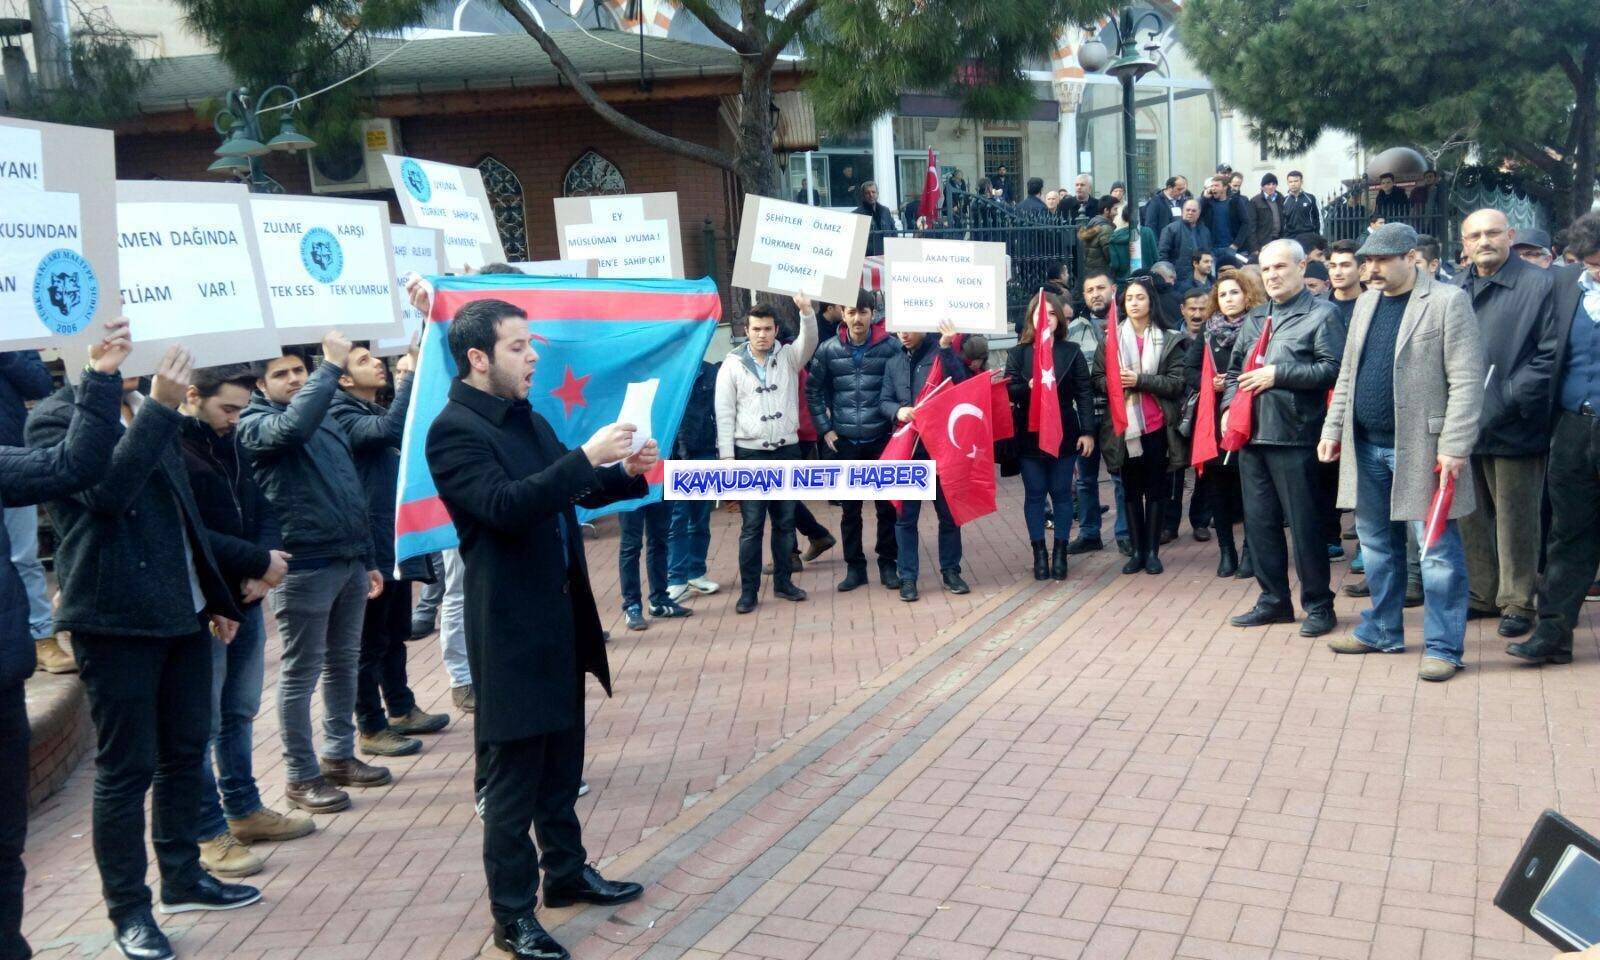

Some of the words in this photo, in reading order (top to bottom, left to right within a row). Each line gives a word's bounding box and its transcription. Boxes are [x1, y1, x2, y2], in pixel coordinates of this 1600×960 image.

[612, 213, 623, 221] EY
[766, 213, 803, 226] ŞEHİTLER
[813, 220, 841, 233] ÖLMEZ
[170, 226, 238, 246] DAĞINDA
[263, 222, 303, 234] ZULME
[338, 224, 365, 238] KARŞI
[568, 235, 617, 247] MÜSLÜMAN
[761, 236, 801, 251] TÜRKMEN
[812, 246, 833, 257] DAĞI
[624, 256, 647, 266] SAHİP
[926, 254, 948, 263] AKAN
[777, 263, 812, 275] DÜŞMEZ
[0, 276, 16, 292] N
[912, 275, 944, 284] OLUNCA
[956, 277, 982, 286] NEDEN
[271, 286, 293, 296] TEK
[295, 285, 315, 296] SES
[330, 285, 348, 295] TEK
[350, 285, 389, 295] YUMRUK
[904, 298, 934, 307] HERKES
[948, 301, 984, 310] SUSUYOR
[56, 323, 77, 334] 2006
